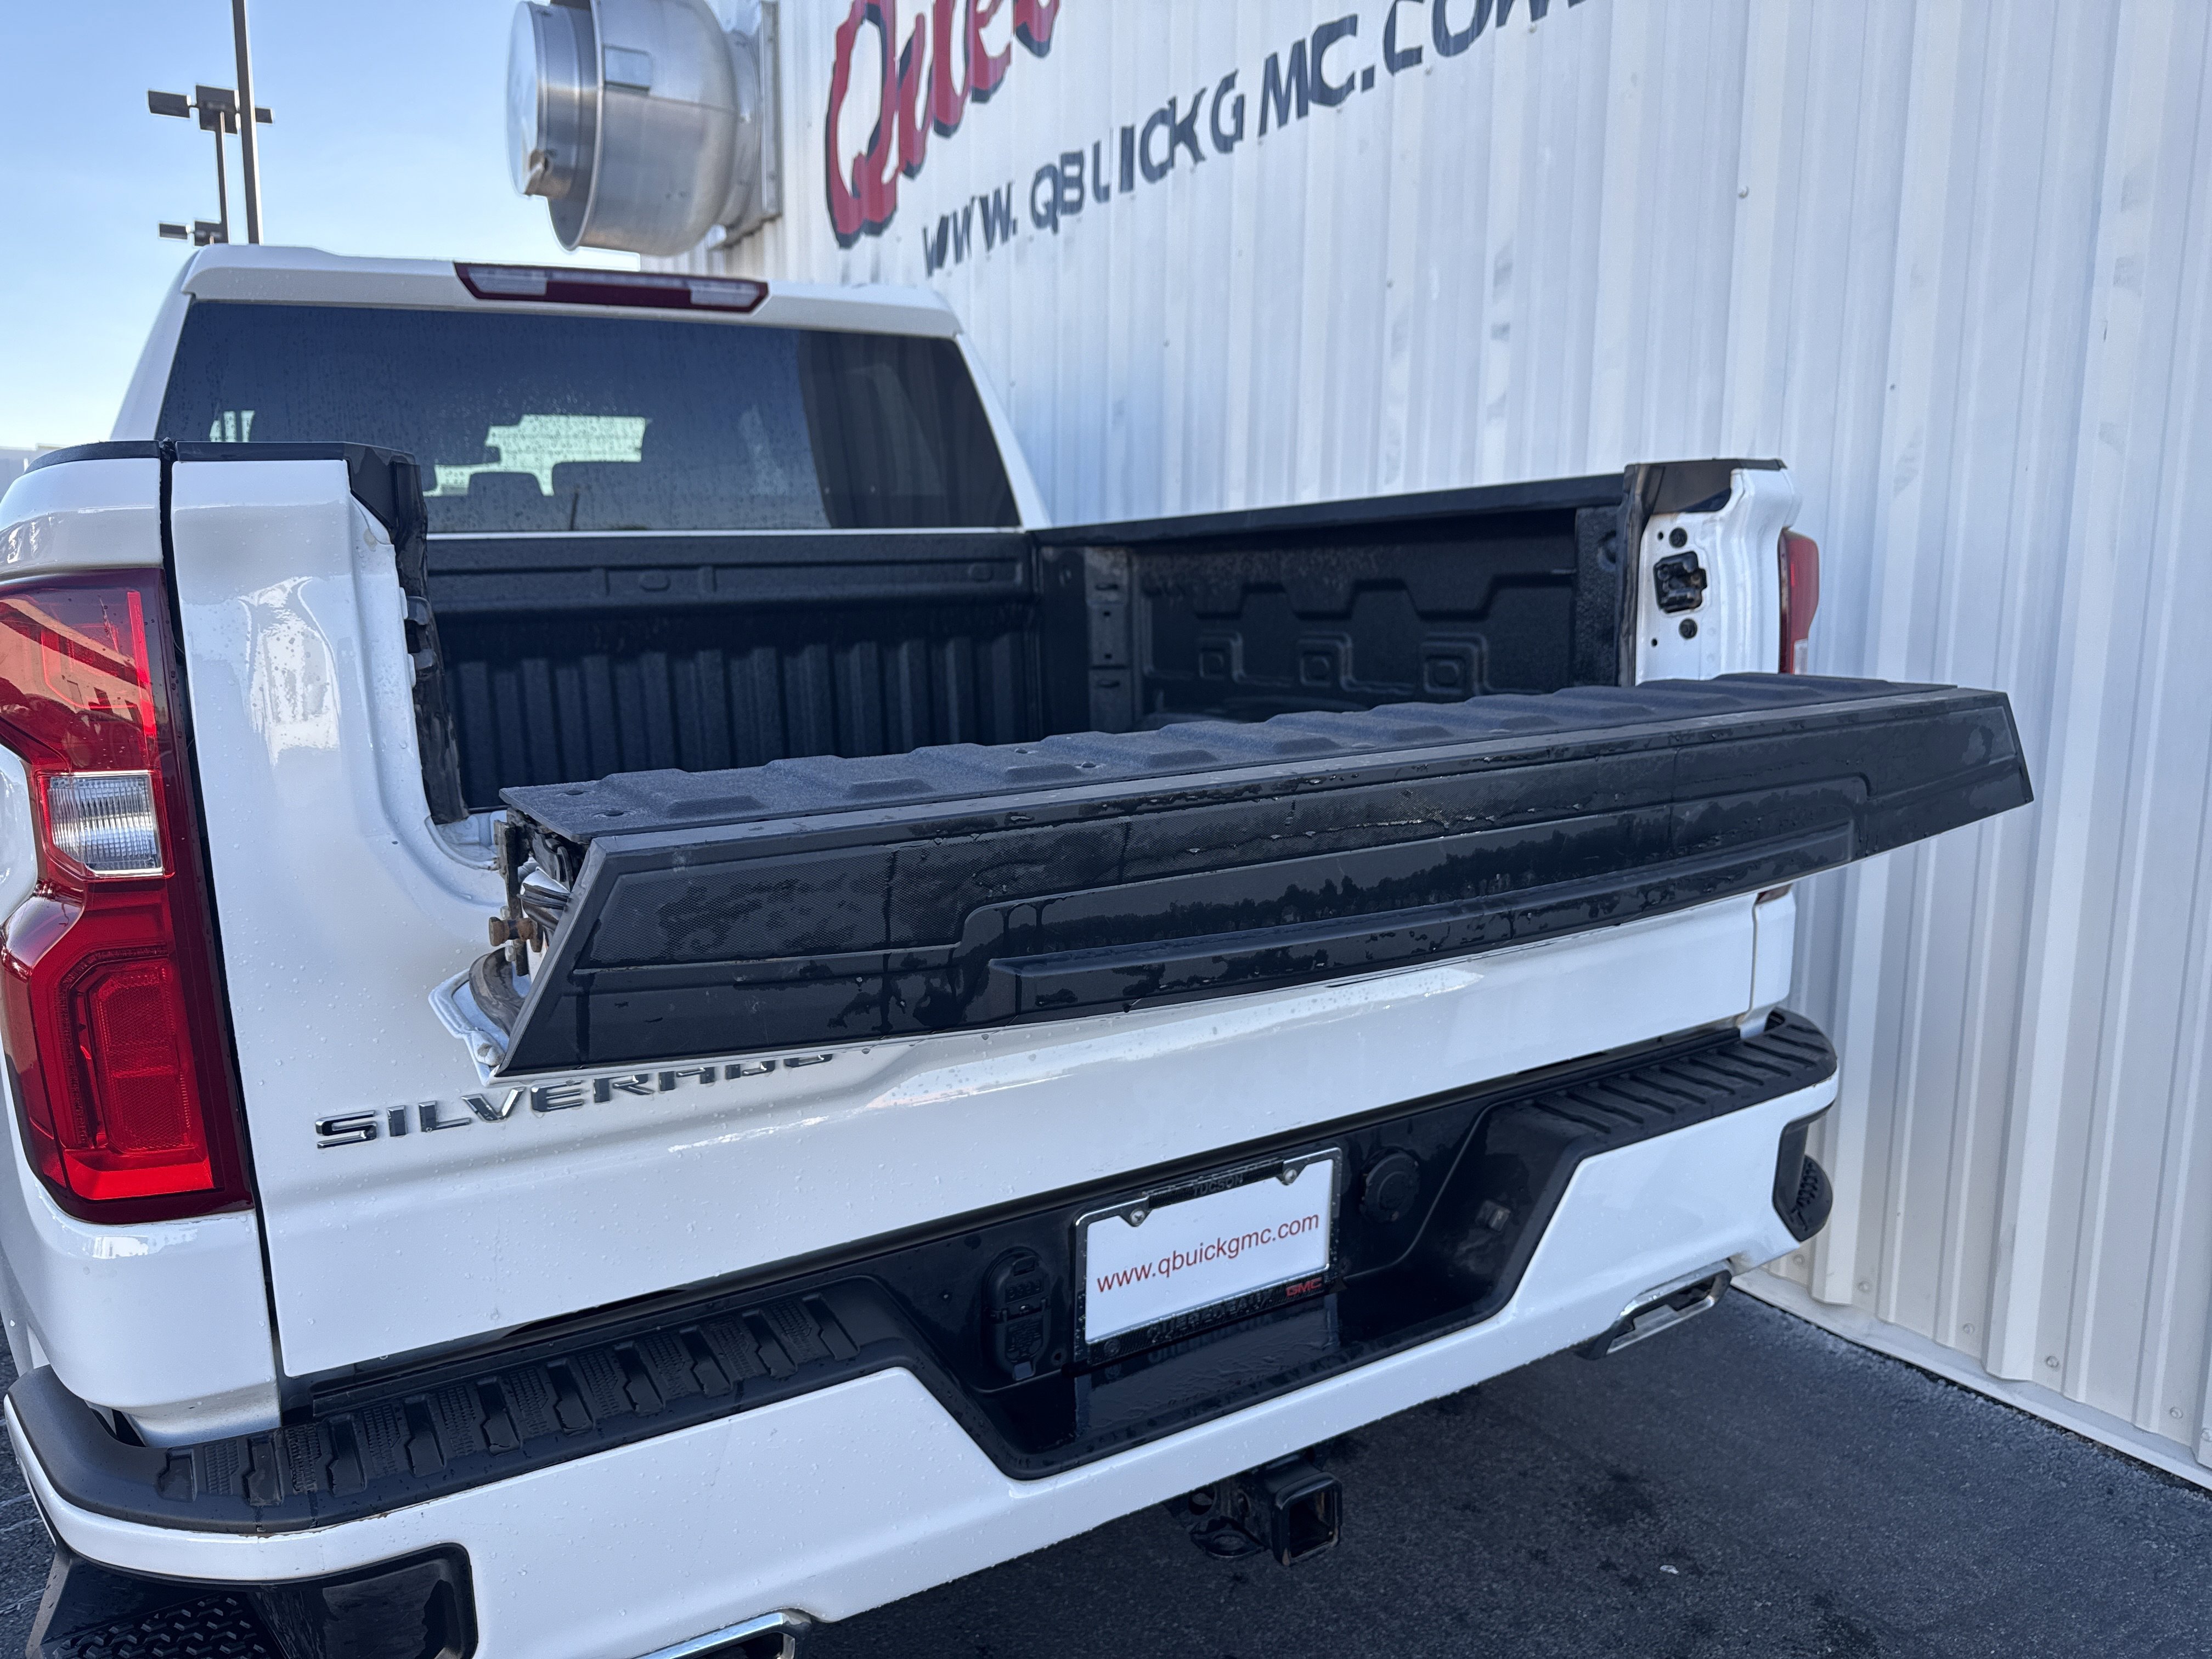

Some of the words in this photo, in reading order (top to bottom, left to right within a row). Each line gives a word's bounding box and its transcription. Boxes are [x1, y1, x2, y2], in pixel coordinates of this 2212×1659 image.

[1193, 1173, 1244, 1197] TUCSON
[1097, 1214, 1319, 1293] www.qbuickgmc.com
[1285, 1277, 1323, 1297] GMC
